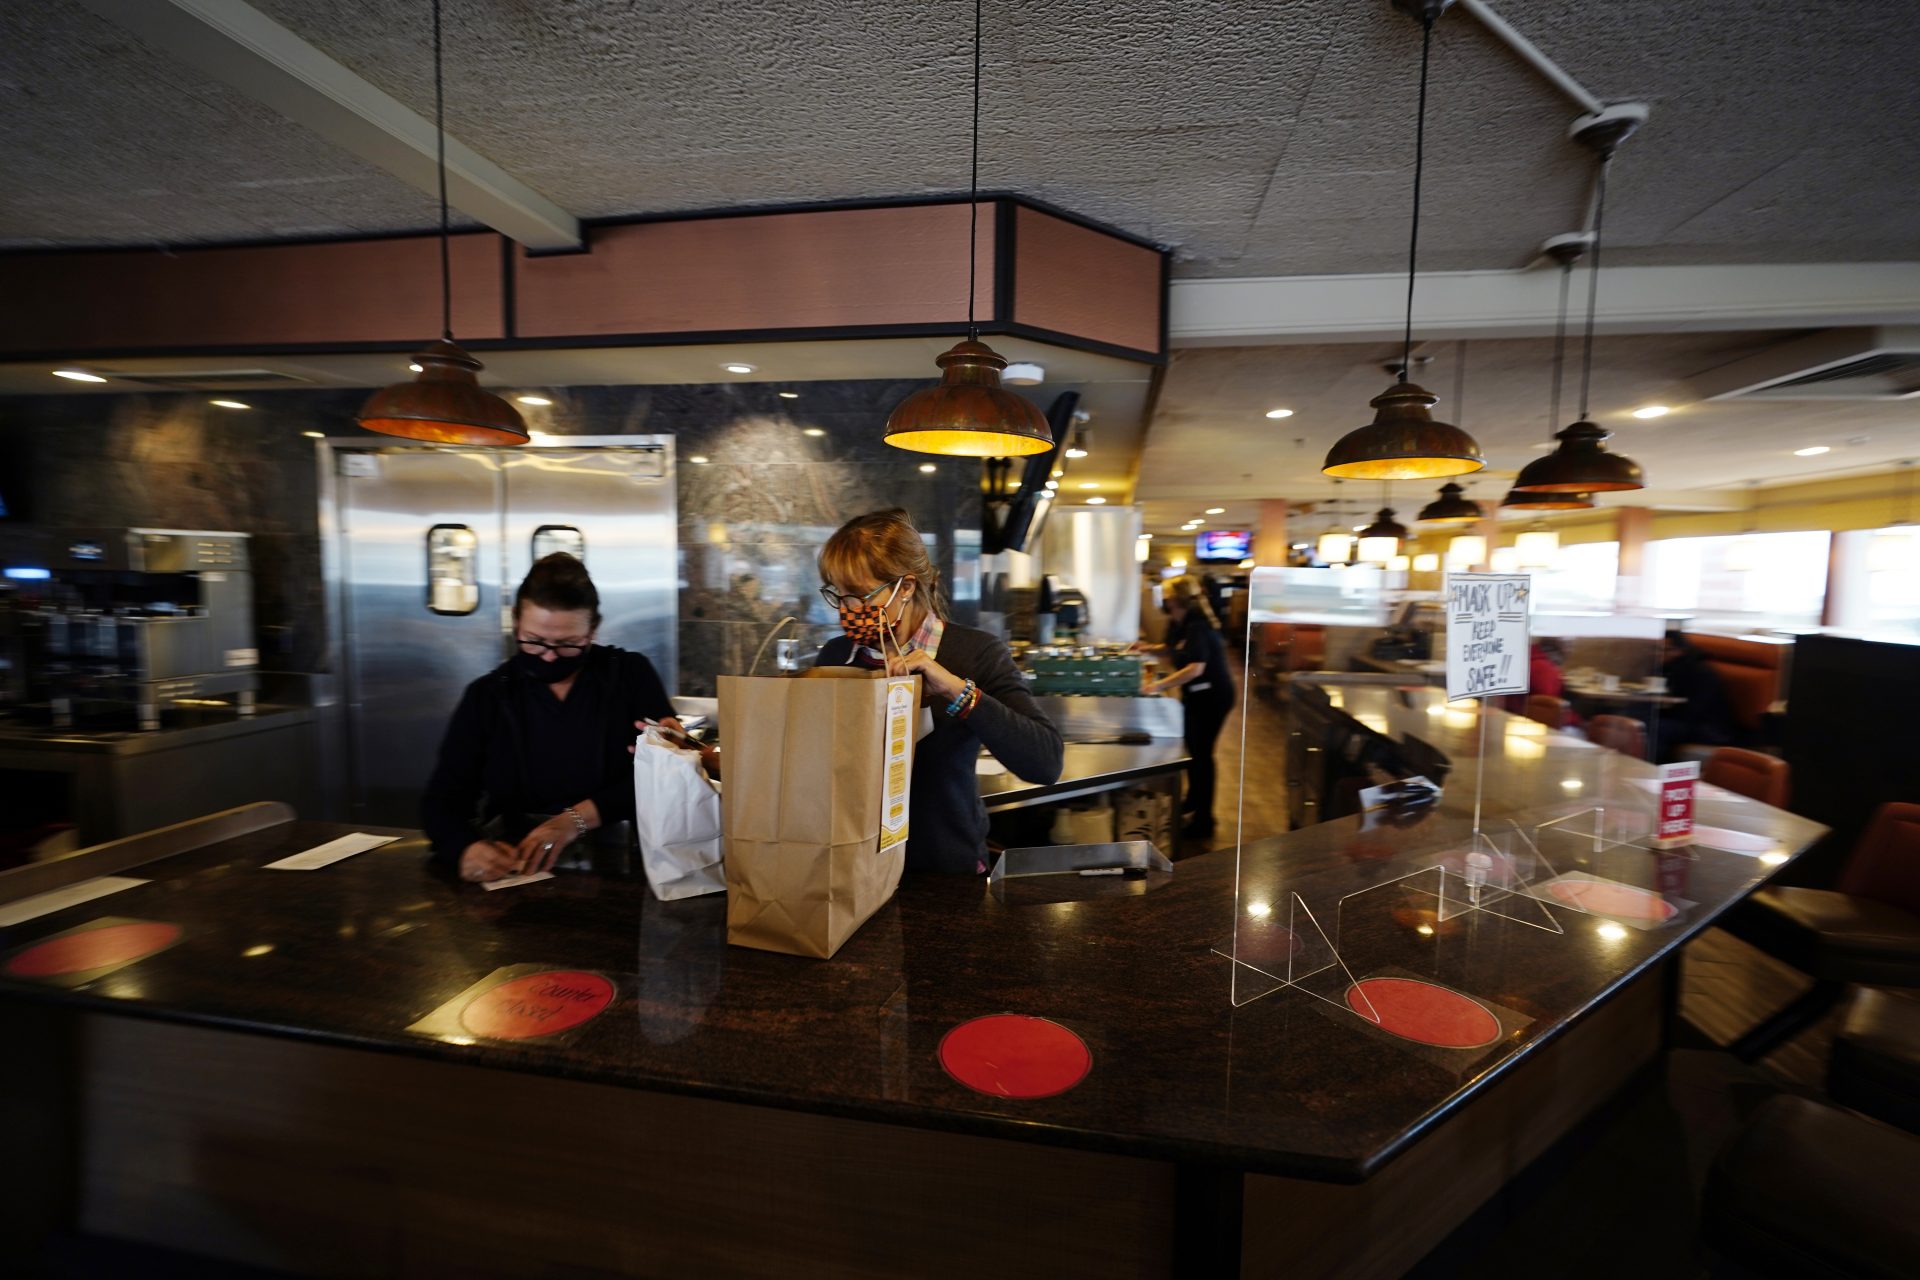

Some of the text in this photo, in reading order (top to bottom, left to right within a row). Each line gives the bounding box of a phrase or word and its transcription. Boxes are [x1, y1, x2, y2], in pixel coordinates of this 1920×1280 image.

[1456, 583, 1514, 615] MASK UP
[1472, 619, 1496, 641] KEEP
[1463, 637, 1504, 662] EVERYONE
